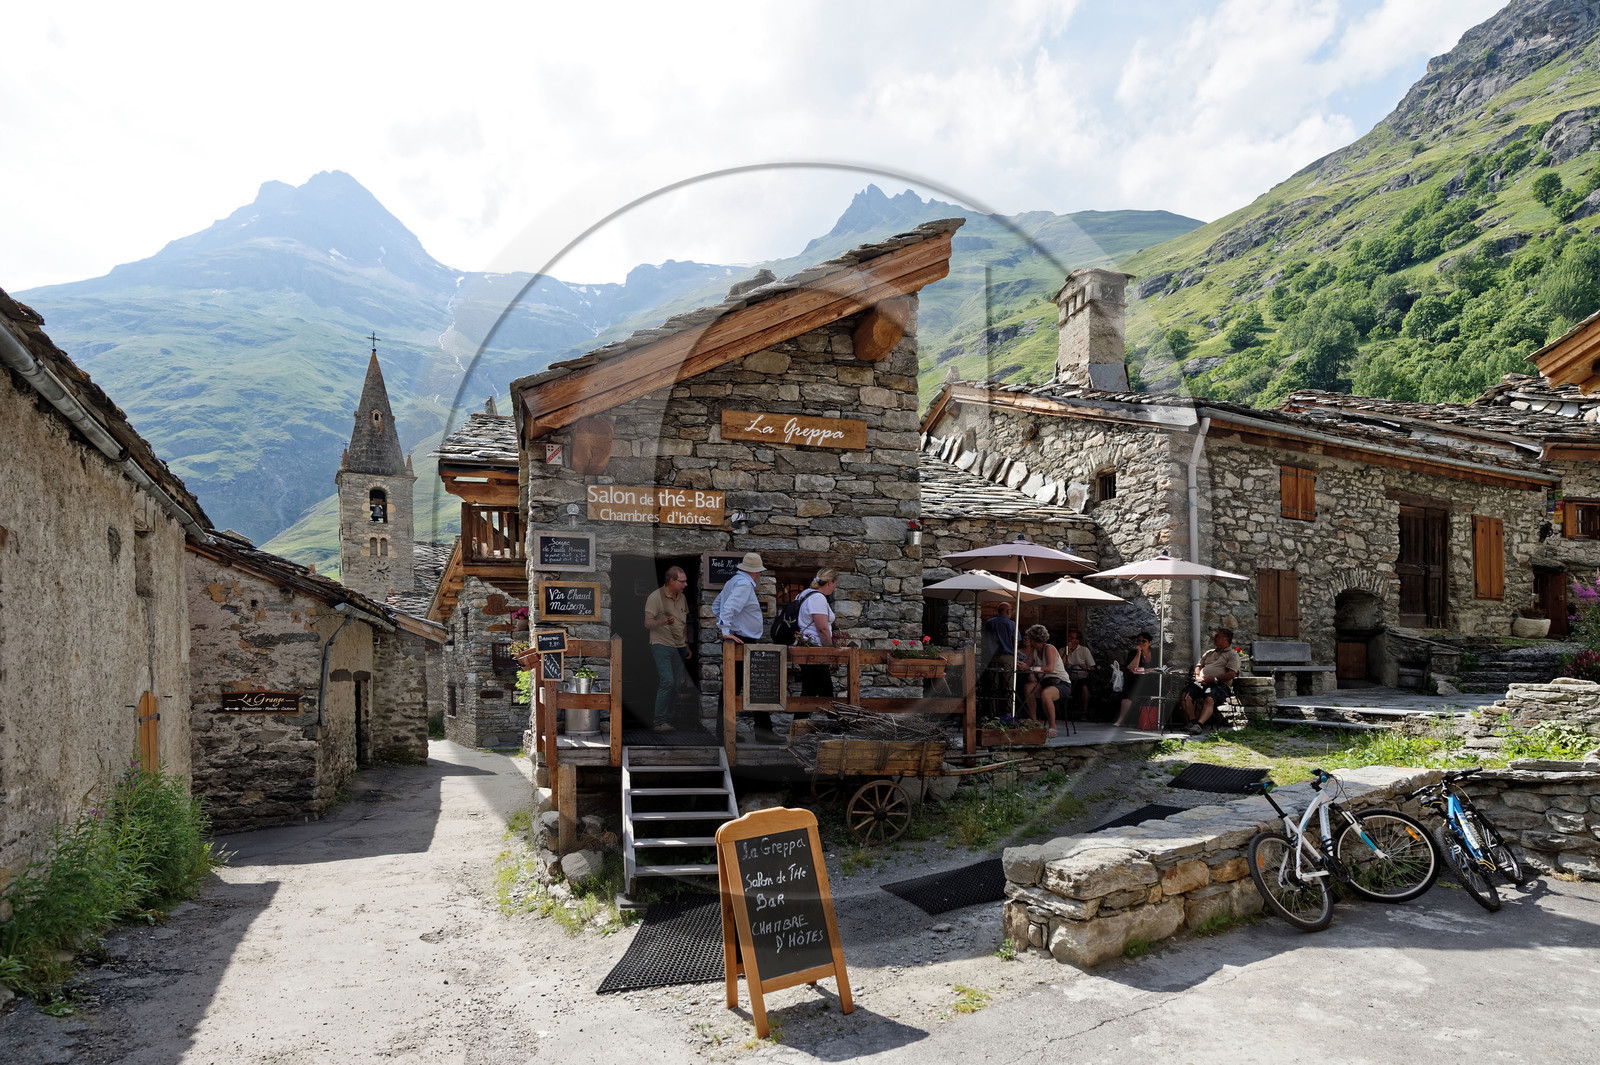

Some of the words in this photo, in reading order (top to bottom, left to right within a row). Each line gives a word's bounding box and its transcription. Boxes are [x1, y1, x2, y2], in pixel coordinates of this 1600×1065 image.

[744, 414, 774, 434] La
[783, 417, 845, 446] Greppa
[587, 485, 636, 505] Salon
[639, 493, 654, 506] de
[599, 508, 660, 523] Chambres
[666, 511, 712, 525] d'hôtes
[549, 588, 565, 601] Vin
[567, 588, 592, 600] Chaud
[549, 601, 586, 611] Maison
[253, 693, 285, 707] Grange
[760, 837, 806, 858] Greppa
[744, 871, 774, 892] Salon
[776, 870, 786, 884] de
[751, 914, 809, 936] CHAMBRE
[776, 929, 824, 954] D'HÔTES
